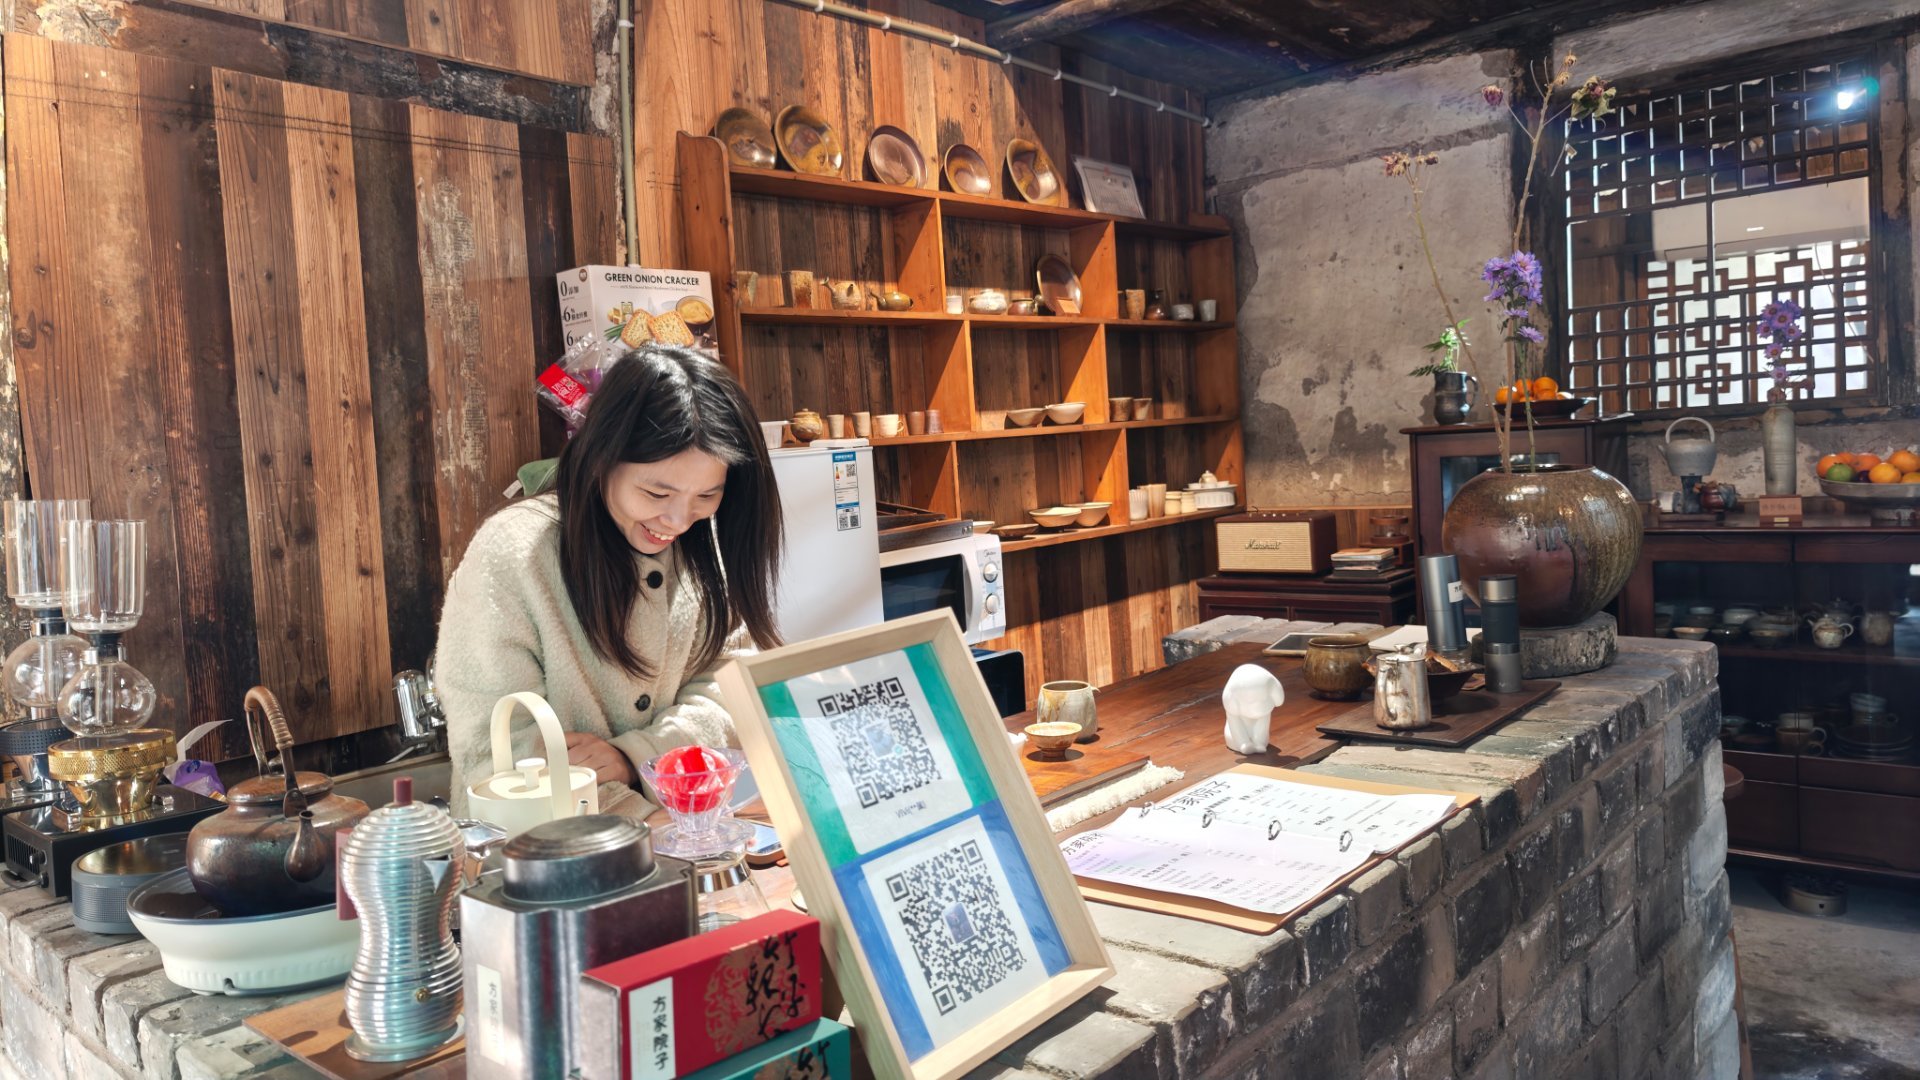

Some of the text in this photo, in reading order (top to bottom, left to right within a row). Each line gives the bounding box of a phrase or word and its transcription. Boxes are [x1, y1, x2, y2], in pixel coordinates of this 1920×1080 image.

[605, 272, 700, 286] GREEN ONION CRACKER
[1154, 780, 1231, 813] 方家院子
[1062, 833, 1104, 856] 方家院子
[652, 995, 669, 1070] 方家院子
